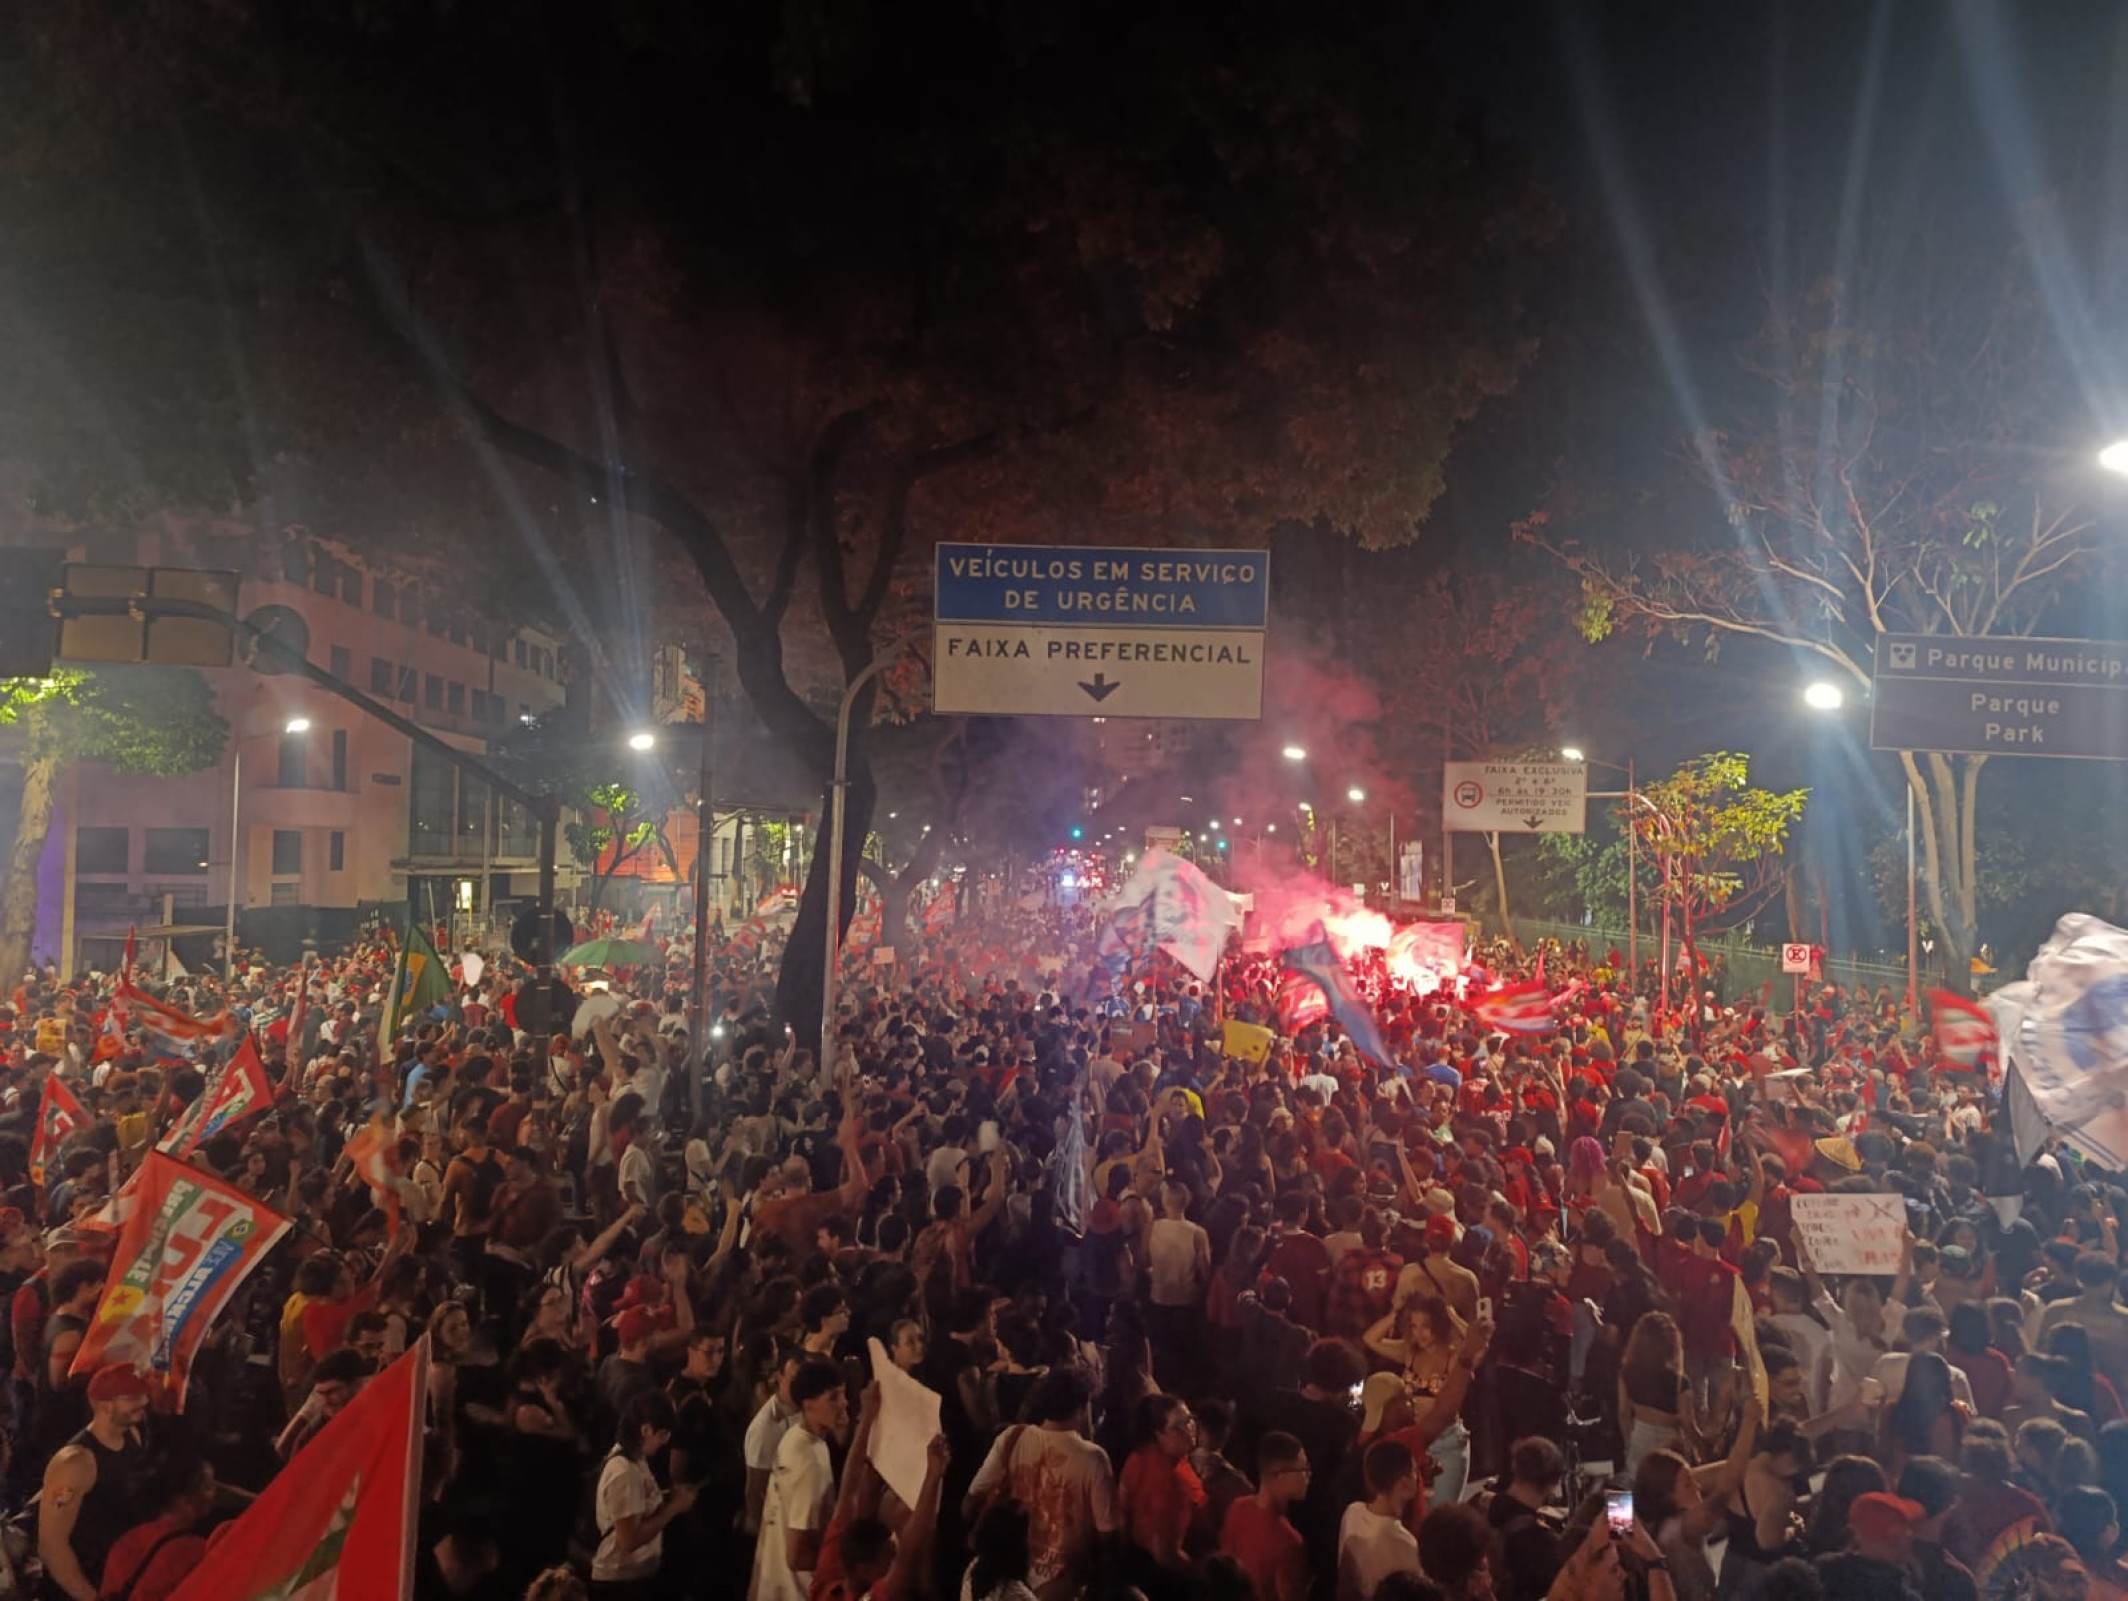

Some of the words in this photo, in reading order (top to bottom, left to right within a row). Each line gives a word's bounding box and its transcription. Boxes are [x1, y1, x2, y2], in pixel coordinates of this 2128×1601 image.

[950, 549, 1081, 579] VEÍCULOS
[1093, 561, 1129, 581] EM
[1140, 563, 1256, 585] SERVIÇO
[1004, 590, 1039, 610] DE
[1058, 587, 1196, 613] URGÊNCIA
[948, 638, 1030, 659] FAIXA
[1047, 641, 1251, 664] PREFERENCIAL
[1927, 649, 2015, 673] Parque
[1971, 693, 2060, 717] Parque
[1985, 723, 2044, 743] Park
[1484, 765, 1517, 775] FAIXA
[1523, 766, 1584, 776] EXCLUSIVA
[1366, 1270, 1387, 1291] 13
